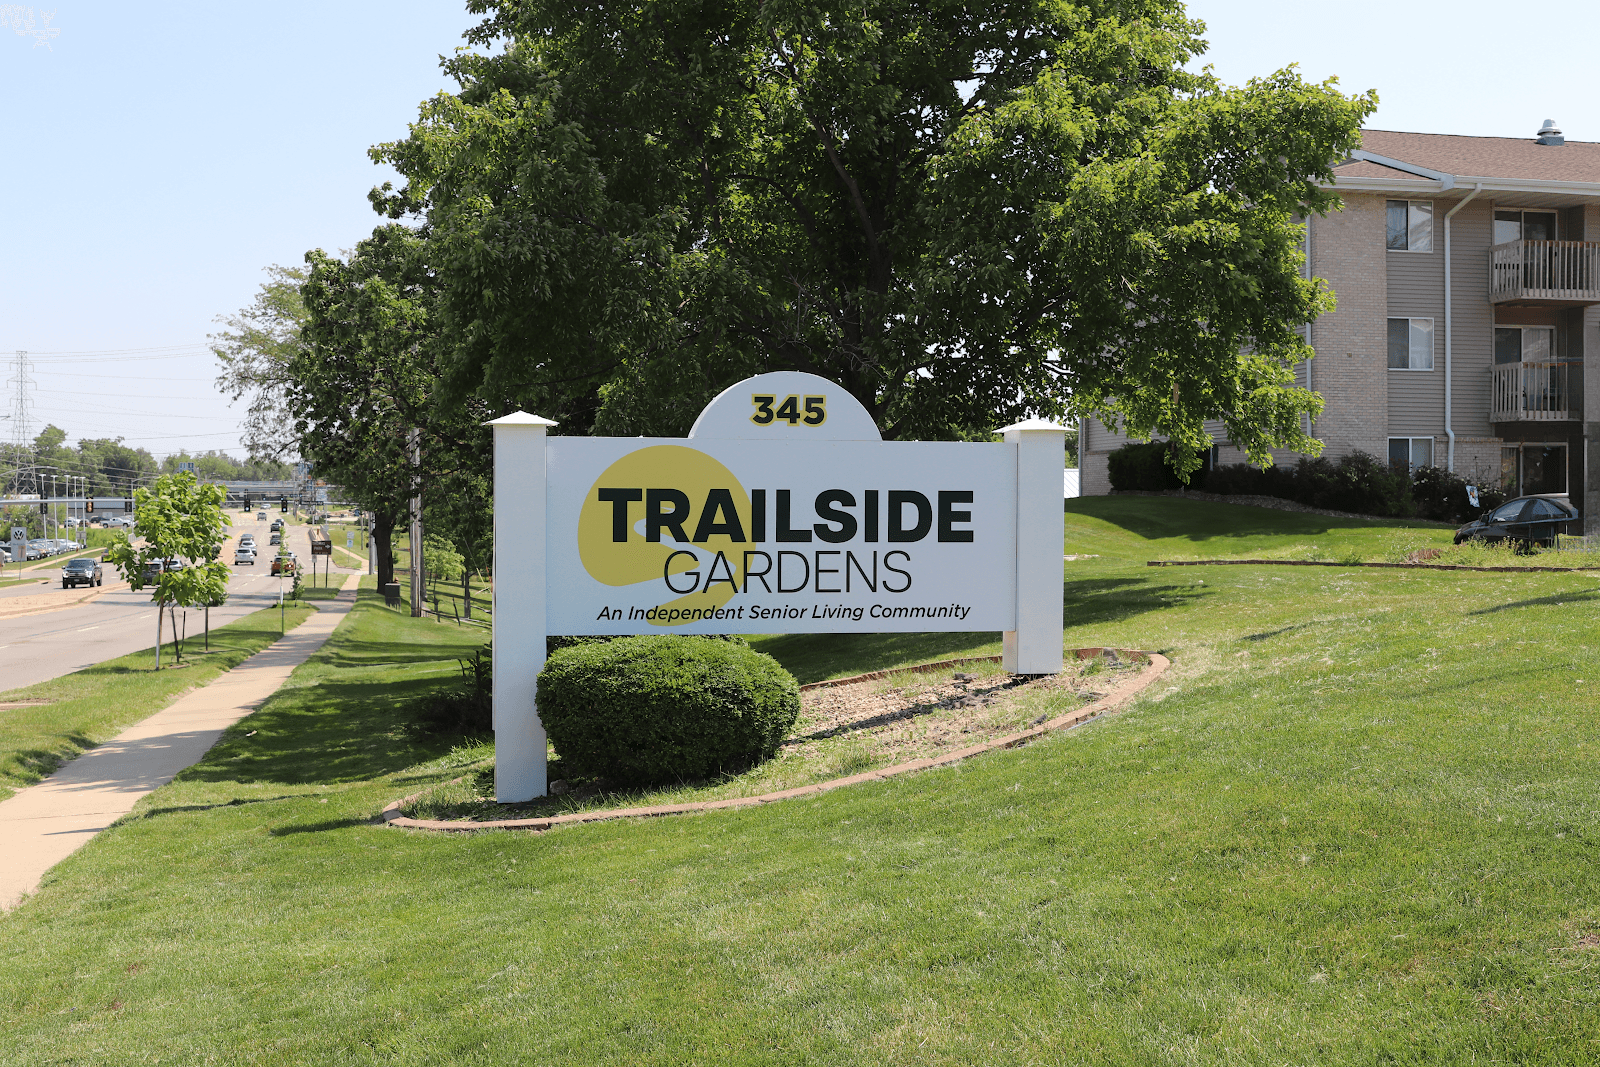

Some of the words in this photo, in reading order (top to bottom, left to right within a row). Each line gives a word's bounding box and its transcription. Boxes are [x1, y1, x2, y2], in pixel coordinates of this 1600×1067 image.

[750, 394, 827, 427] 345
[598, 488, 974, 543] TRAILSIDE
[664, 550, 912, 594] GARDENS
[596, 606, 623, 621] An
[628, 605, 745, 622] Independent
[748, 605, 808, 620] Senior
[812, 604, 864, 621] Living
[869, 604, 971, 620] Community
